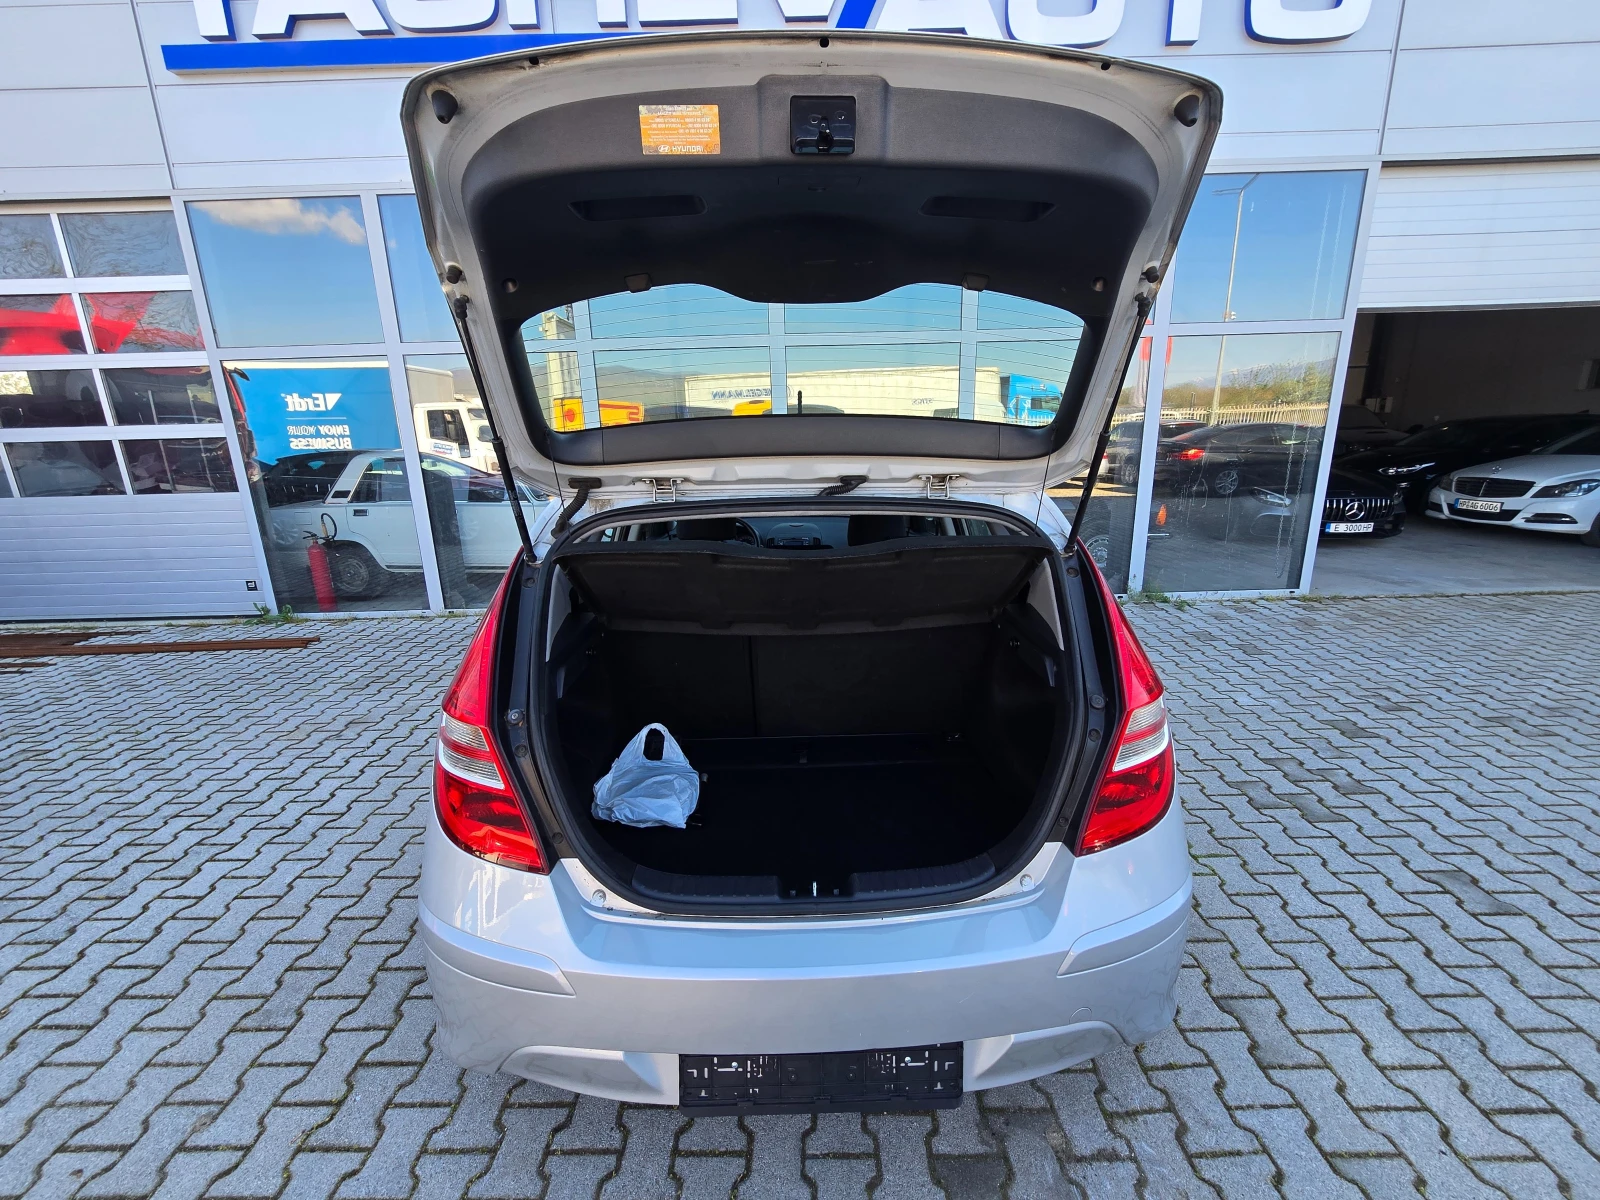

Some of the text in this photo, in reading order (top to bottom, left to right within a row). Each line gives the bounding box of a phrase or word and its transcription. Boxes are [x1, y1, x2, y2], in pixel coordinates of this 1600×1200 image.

[1459, 500, 1499, 511] HP AG 6006
